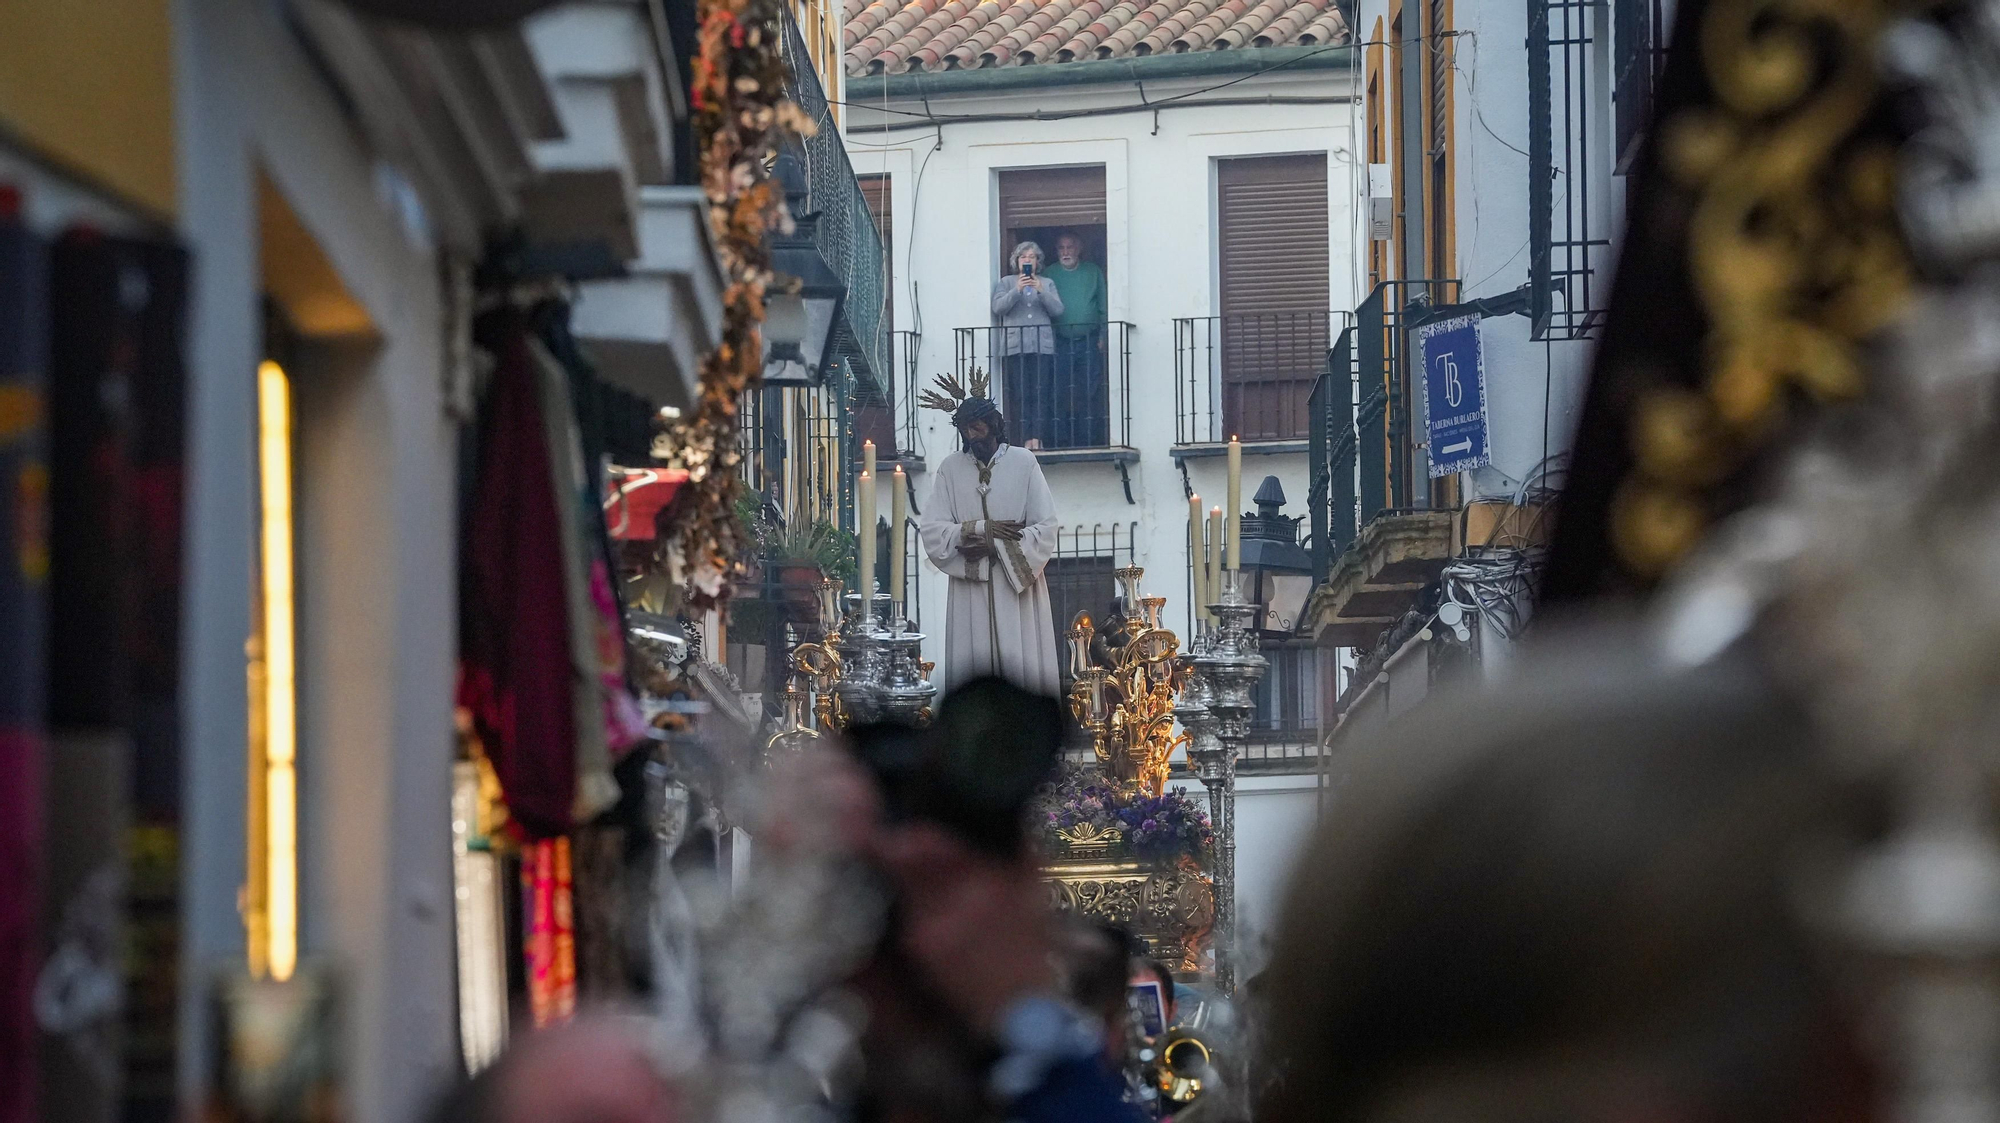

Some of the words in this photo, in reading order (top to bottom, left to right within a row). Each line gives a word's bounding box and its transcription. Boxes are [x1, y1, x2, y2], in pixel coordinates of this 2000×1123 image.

[1435, 351, 1462, 408] TB
[1431, 417, 1454, 430] TABERNA
[1453, 411, 1481, 425] BURLAERO
